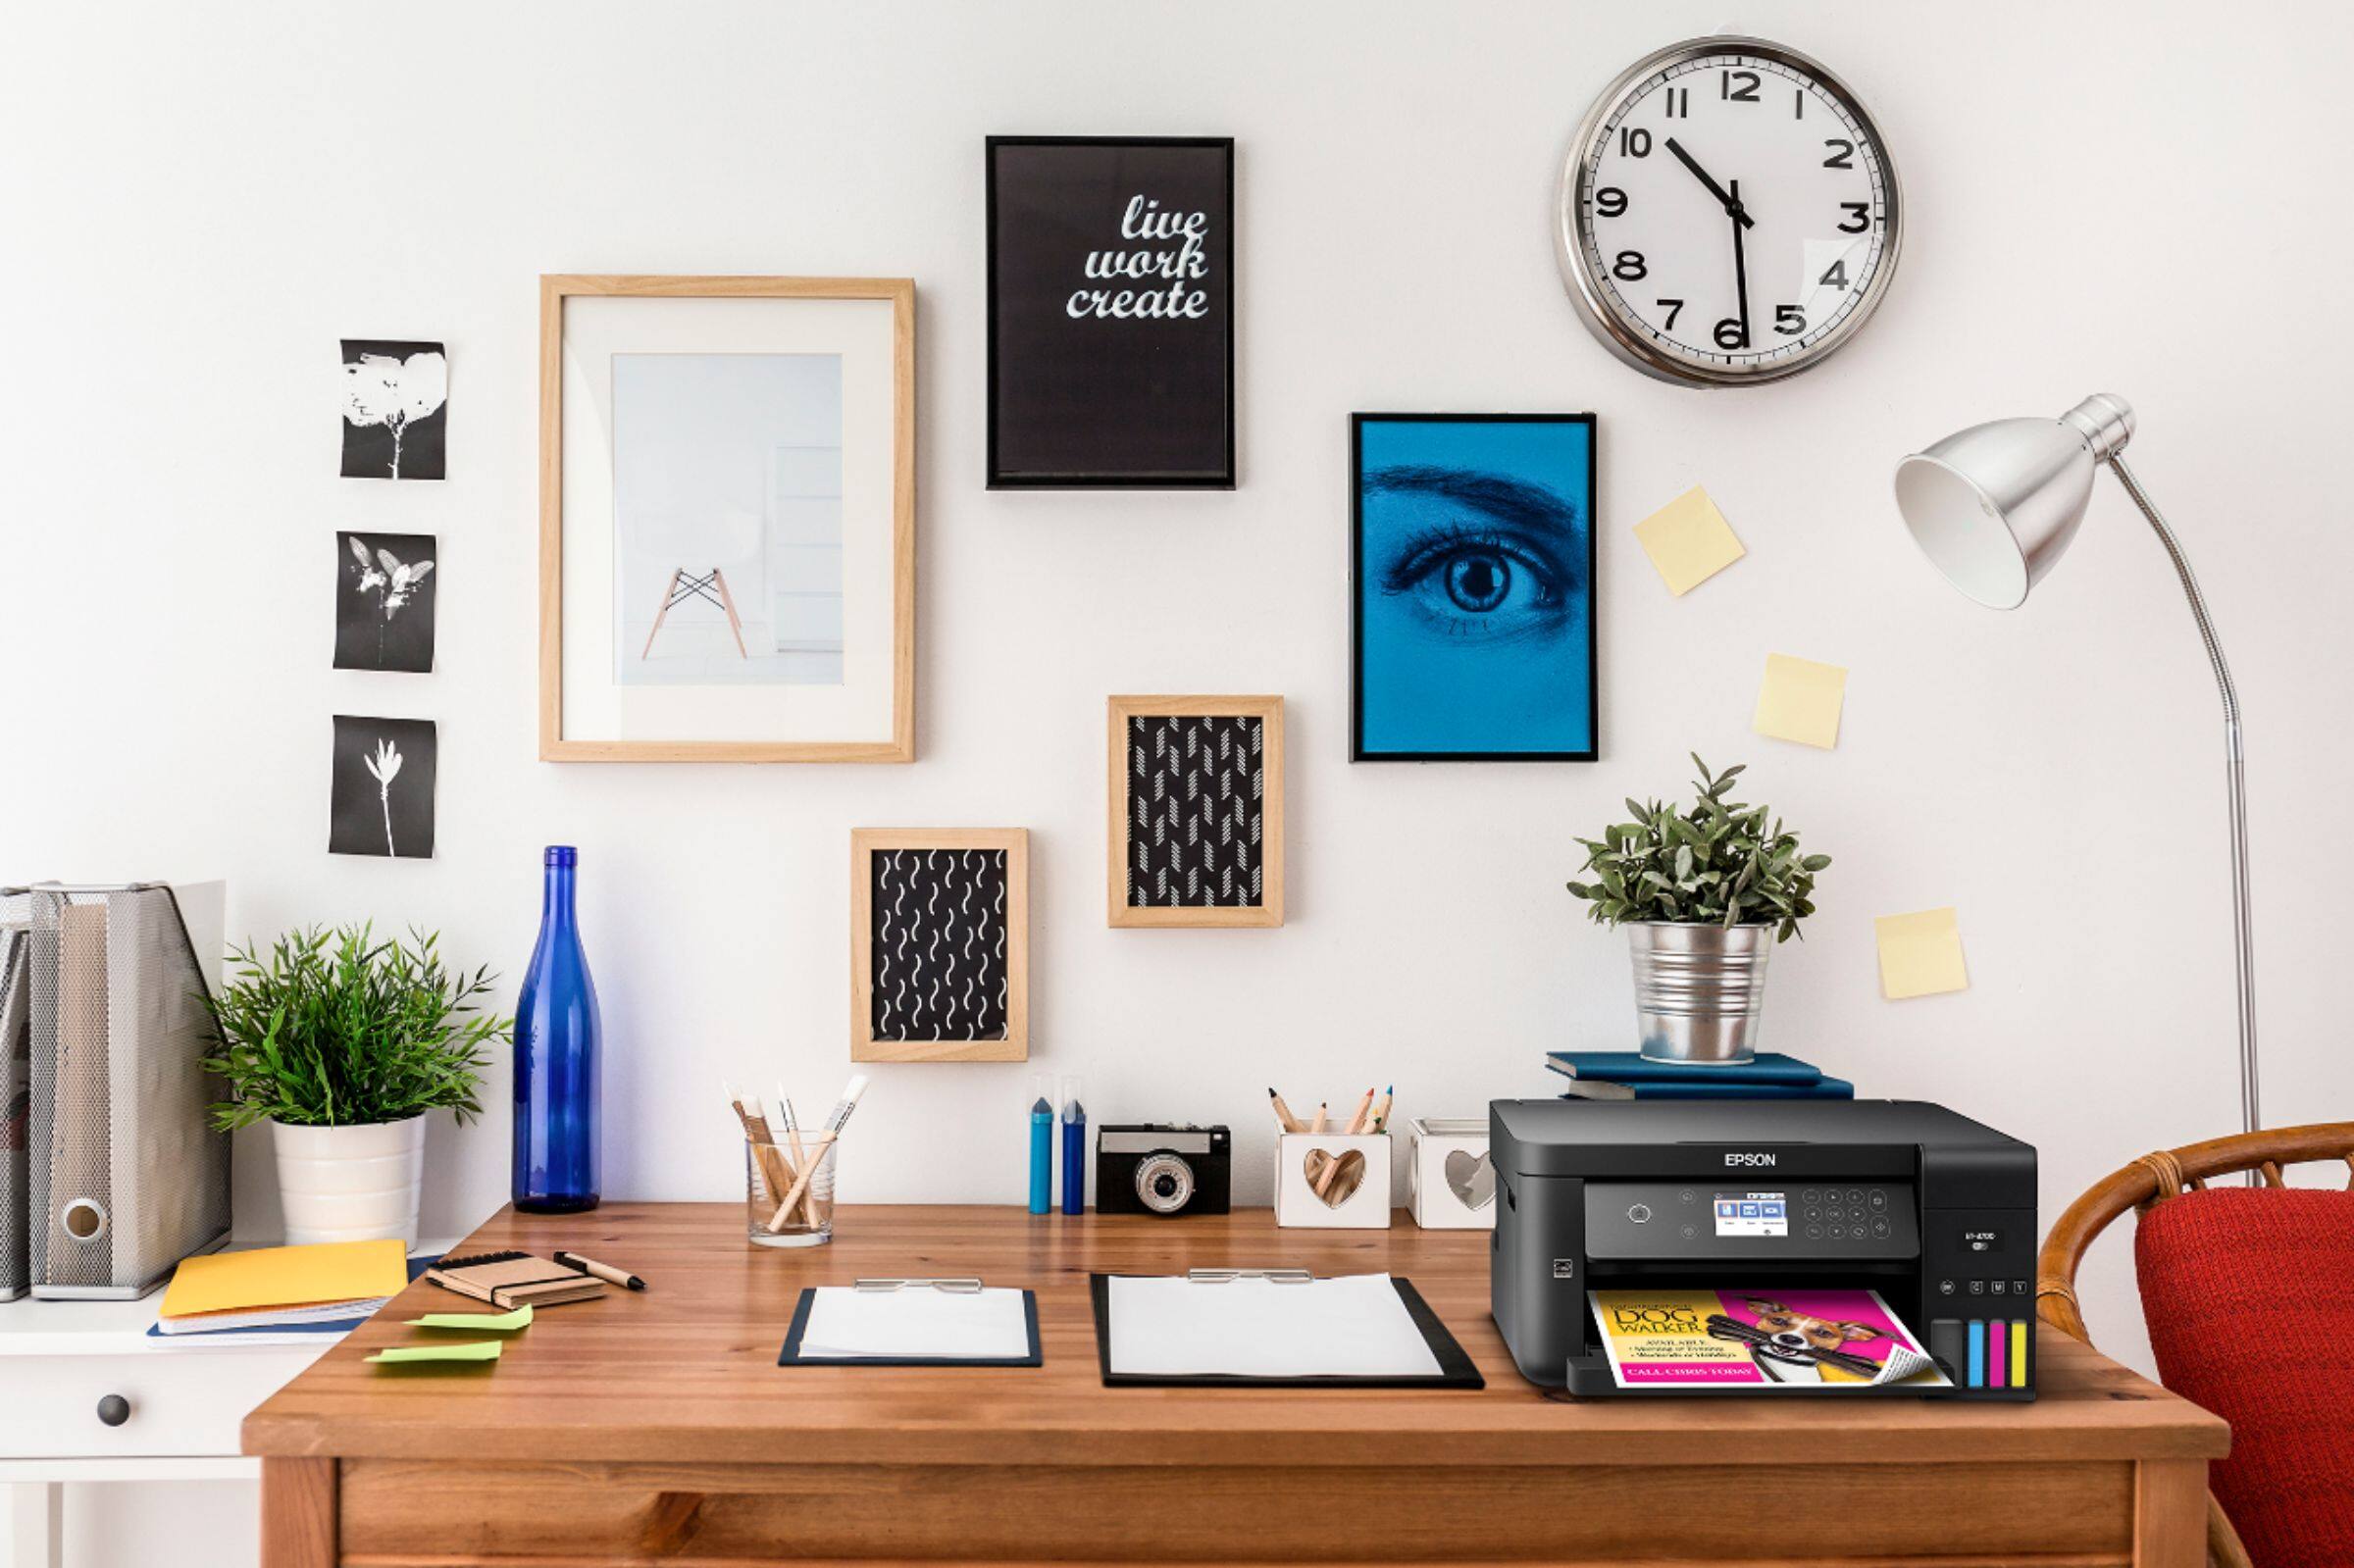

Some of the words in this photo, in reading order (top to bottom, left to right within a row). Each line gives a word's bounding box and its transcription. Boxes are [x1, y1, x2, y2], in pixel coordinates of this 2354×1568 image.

[1721, 71, 1761, 102] 12
[1666, 88, 1687, 118] 11
[1796, 89, 1803, 120] 1
[1620, 126, 1652, 157] 10
[1822, 139, 1855, 169] 2
[1121, 194, 1208, 239] live
[1596, 187, 1628, 217] 9
[1837, 202, 1870, 233] 3
[1085, 235, 1208, 278] work
[1612, 251, 1648, 281] 8
[1818, 260, 1849, 291] 4
[1066, 280, 1208, 319] create
[1657, 299, 1683, 330] 7
[1714, 319, 1744, 350] 6
[1774, 305, 1807, 334] 5
[1725, 1153, 1775, 1166] EPSON
[1613, 1308, 1698, 1324] DOG
[1617, 1322, 1704, 1333] WALKER
